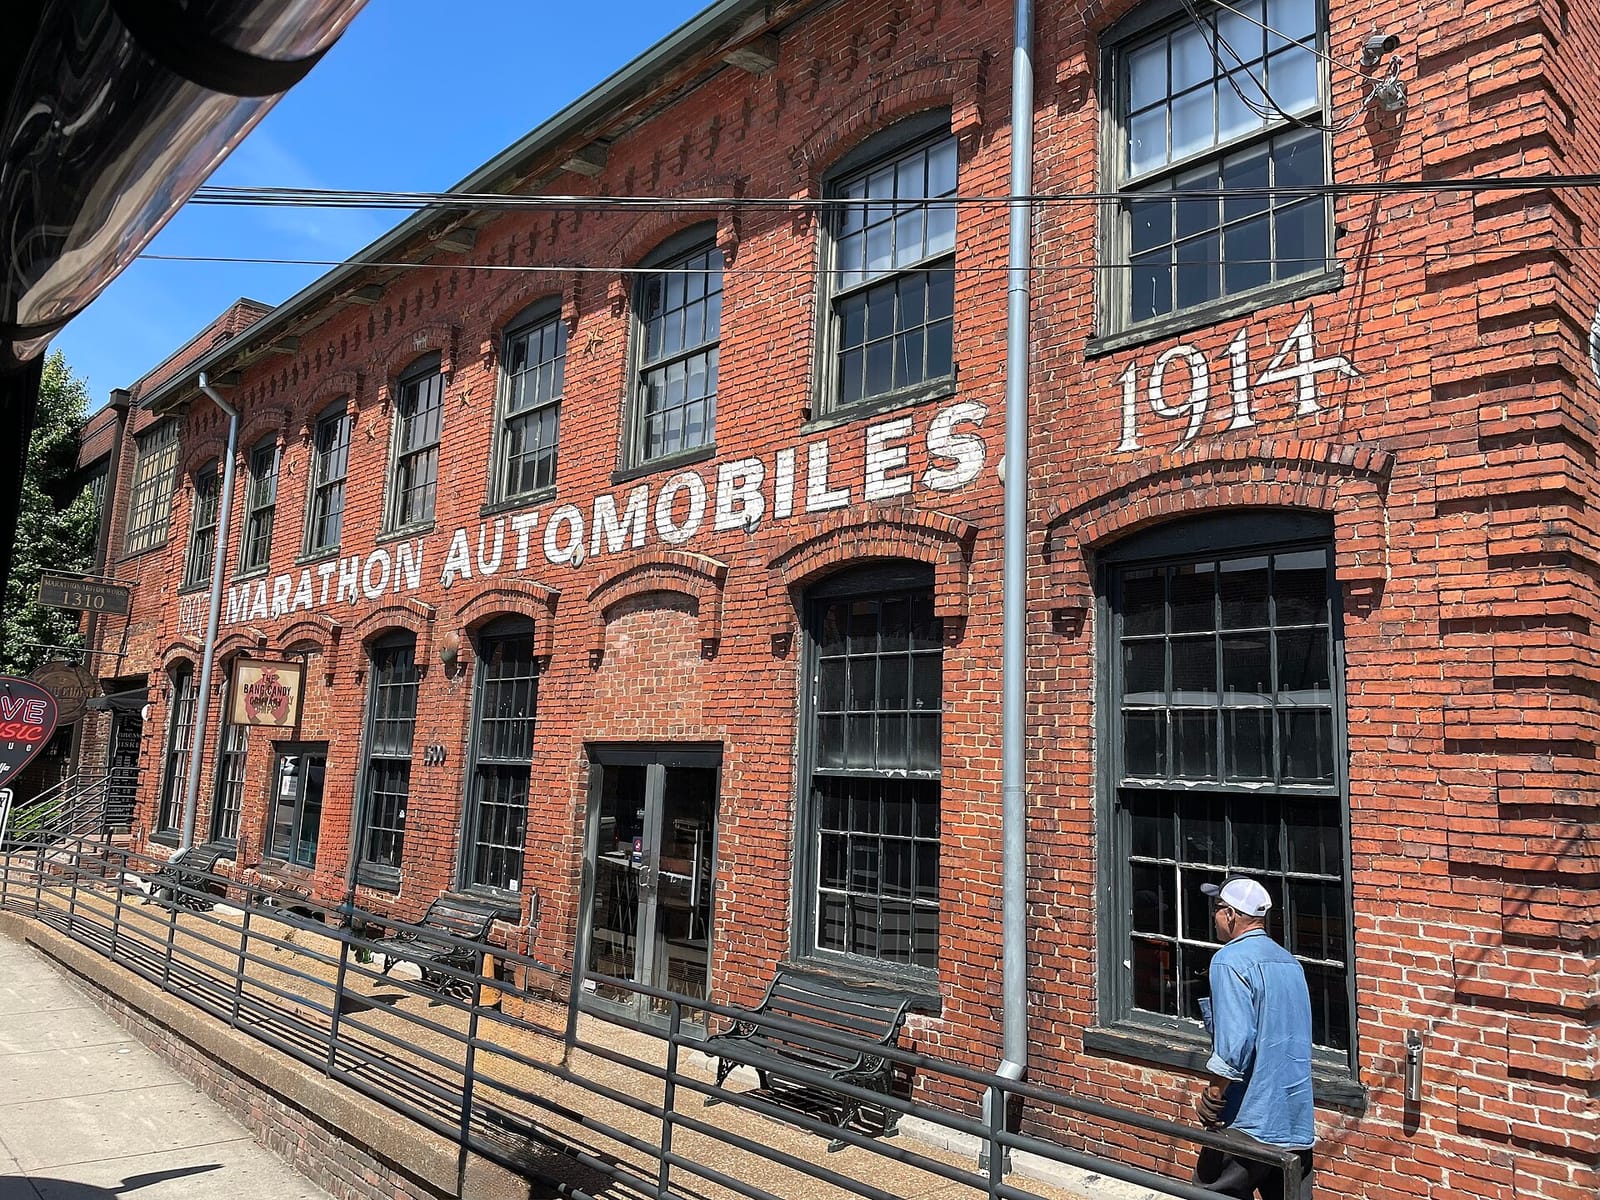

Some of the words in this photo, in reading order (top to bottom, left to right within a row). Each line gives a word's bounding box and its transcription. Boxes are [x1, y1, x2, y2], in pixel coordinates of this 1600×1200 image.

[1113, 302, 1362, 453] 1914
[44, 579, 81, 590] MARATHON
[82, 584, 105, 594] MOTOR
[106, 588, 128, 597] WORKS
[225, 539, 424, 624] MARATHON
[63, 591, 105, 609] 1310
[176, 594, 212, 637] 1907
[262, 673, 276, 683] THE
[243, 683, 265, 697] BANG
[267, 685, 292, 698] CANDY
